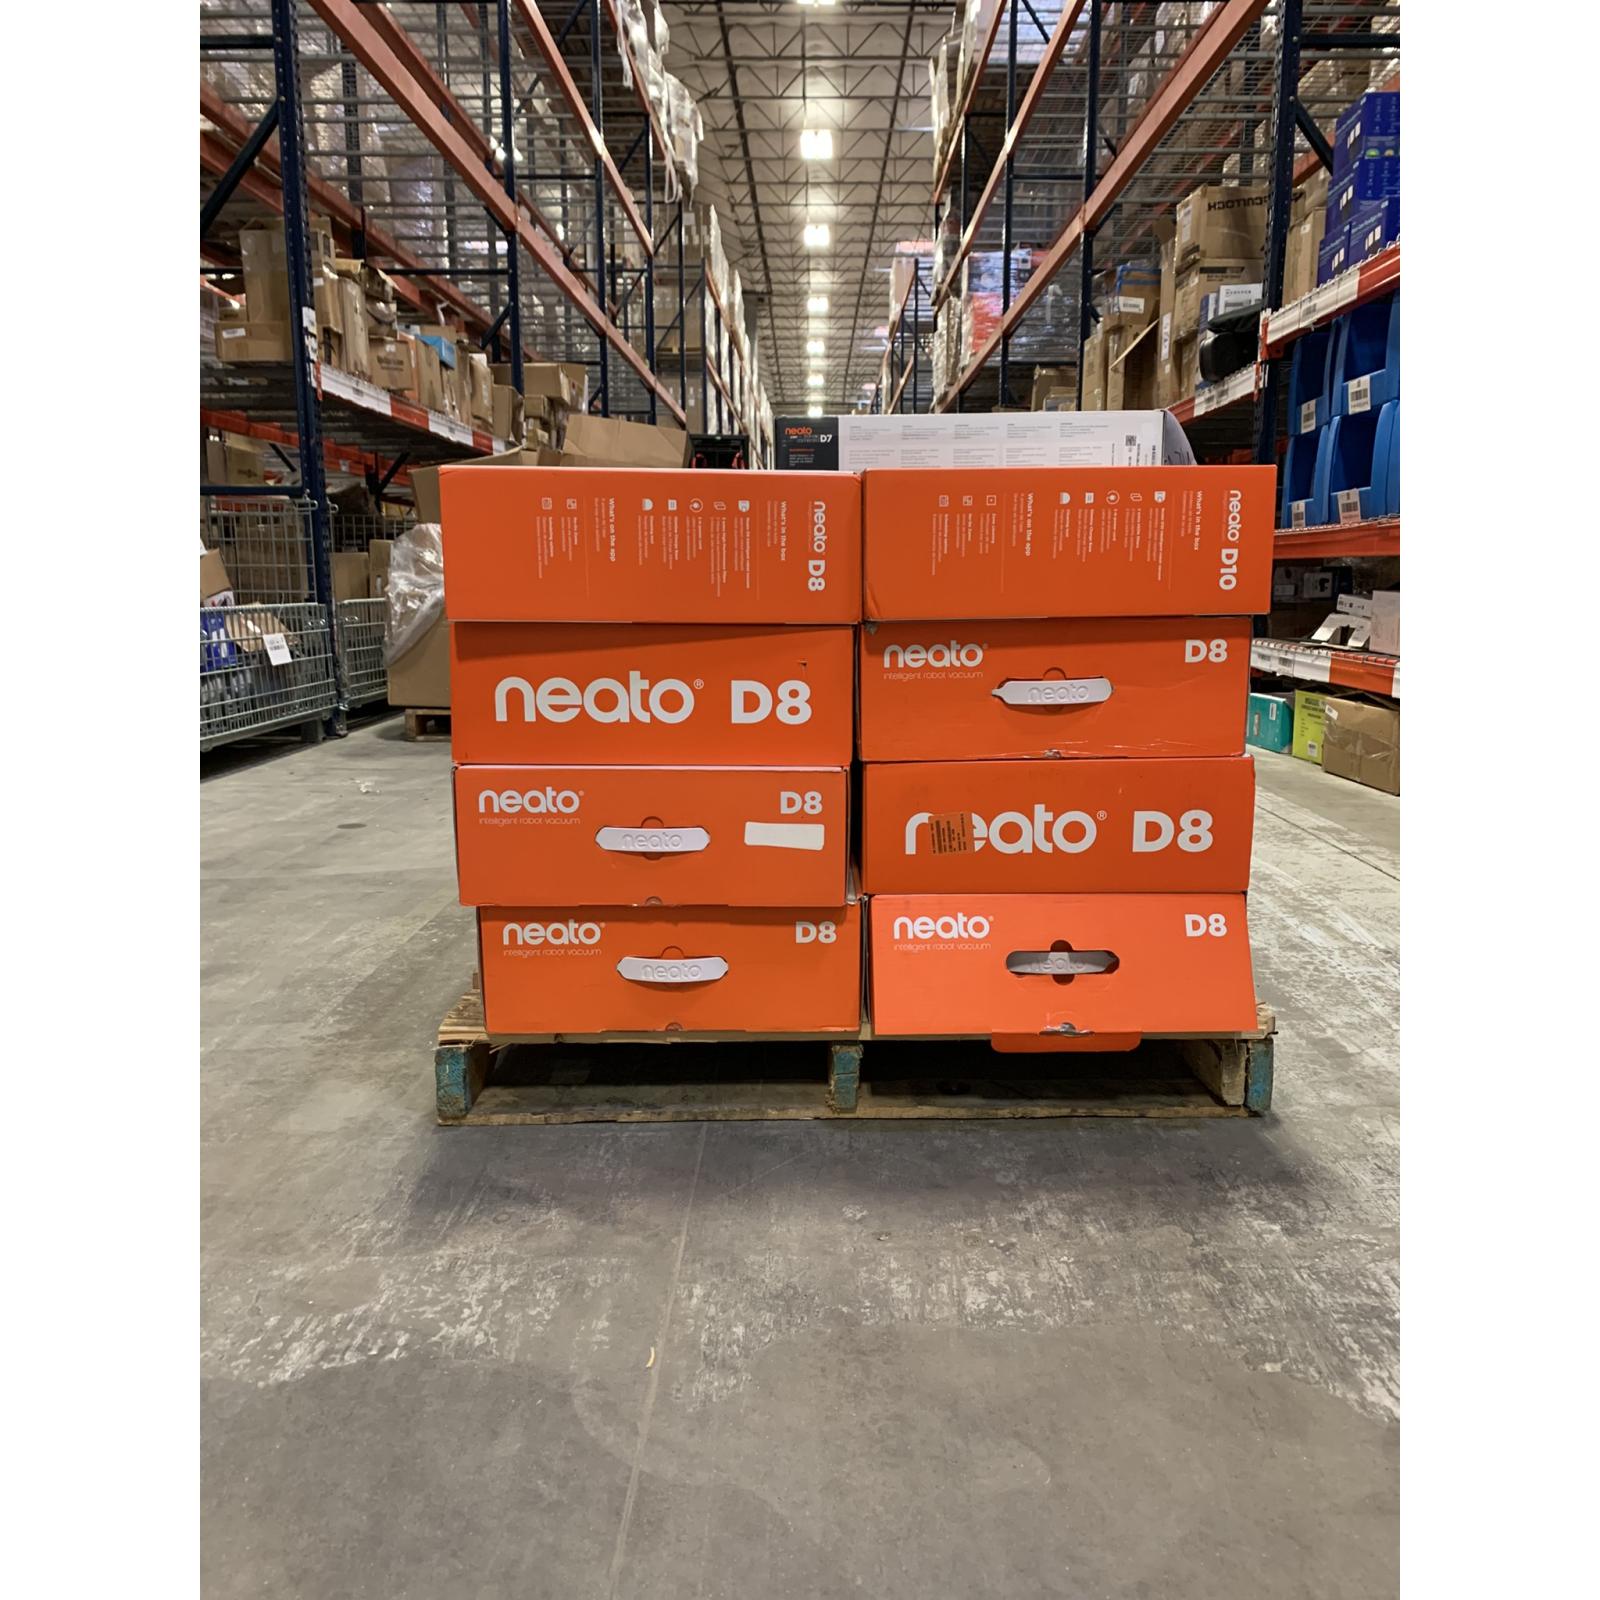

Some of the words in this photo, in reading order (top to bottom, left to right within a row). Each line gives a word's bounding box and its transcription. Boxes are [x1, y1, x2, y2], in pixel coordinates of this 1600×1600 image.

[820, 434, 832, 443] D7
[813, 501, 827, 552] neato
[1227, 489, 1241, 541] neato
[808, 559, 826, 591] D8
[1219, 548, 1238, 590] D10
[883, 640, 984, 668] neato
[1184, 639, 1228, 663] D8
[731, 680, 812, 724] D8
[1027, 682, 1089, 703] neato
[478, 786, 580, 814] neato
[780, 791, 823, 815] D8
[621, 832, 683, 851] neato
[1132, 810, 1213, 853] D8
[502, 919, 601, 945] neato
[796, 922, 837, 944] D8
[893, 912, 990, 940] neato
[1185, 914, 1227, 937] D8
[641, 963, 702, 981] neato
